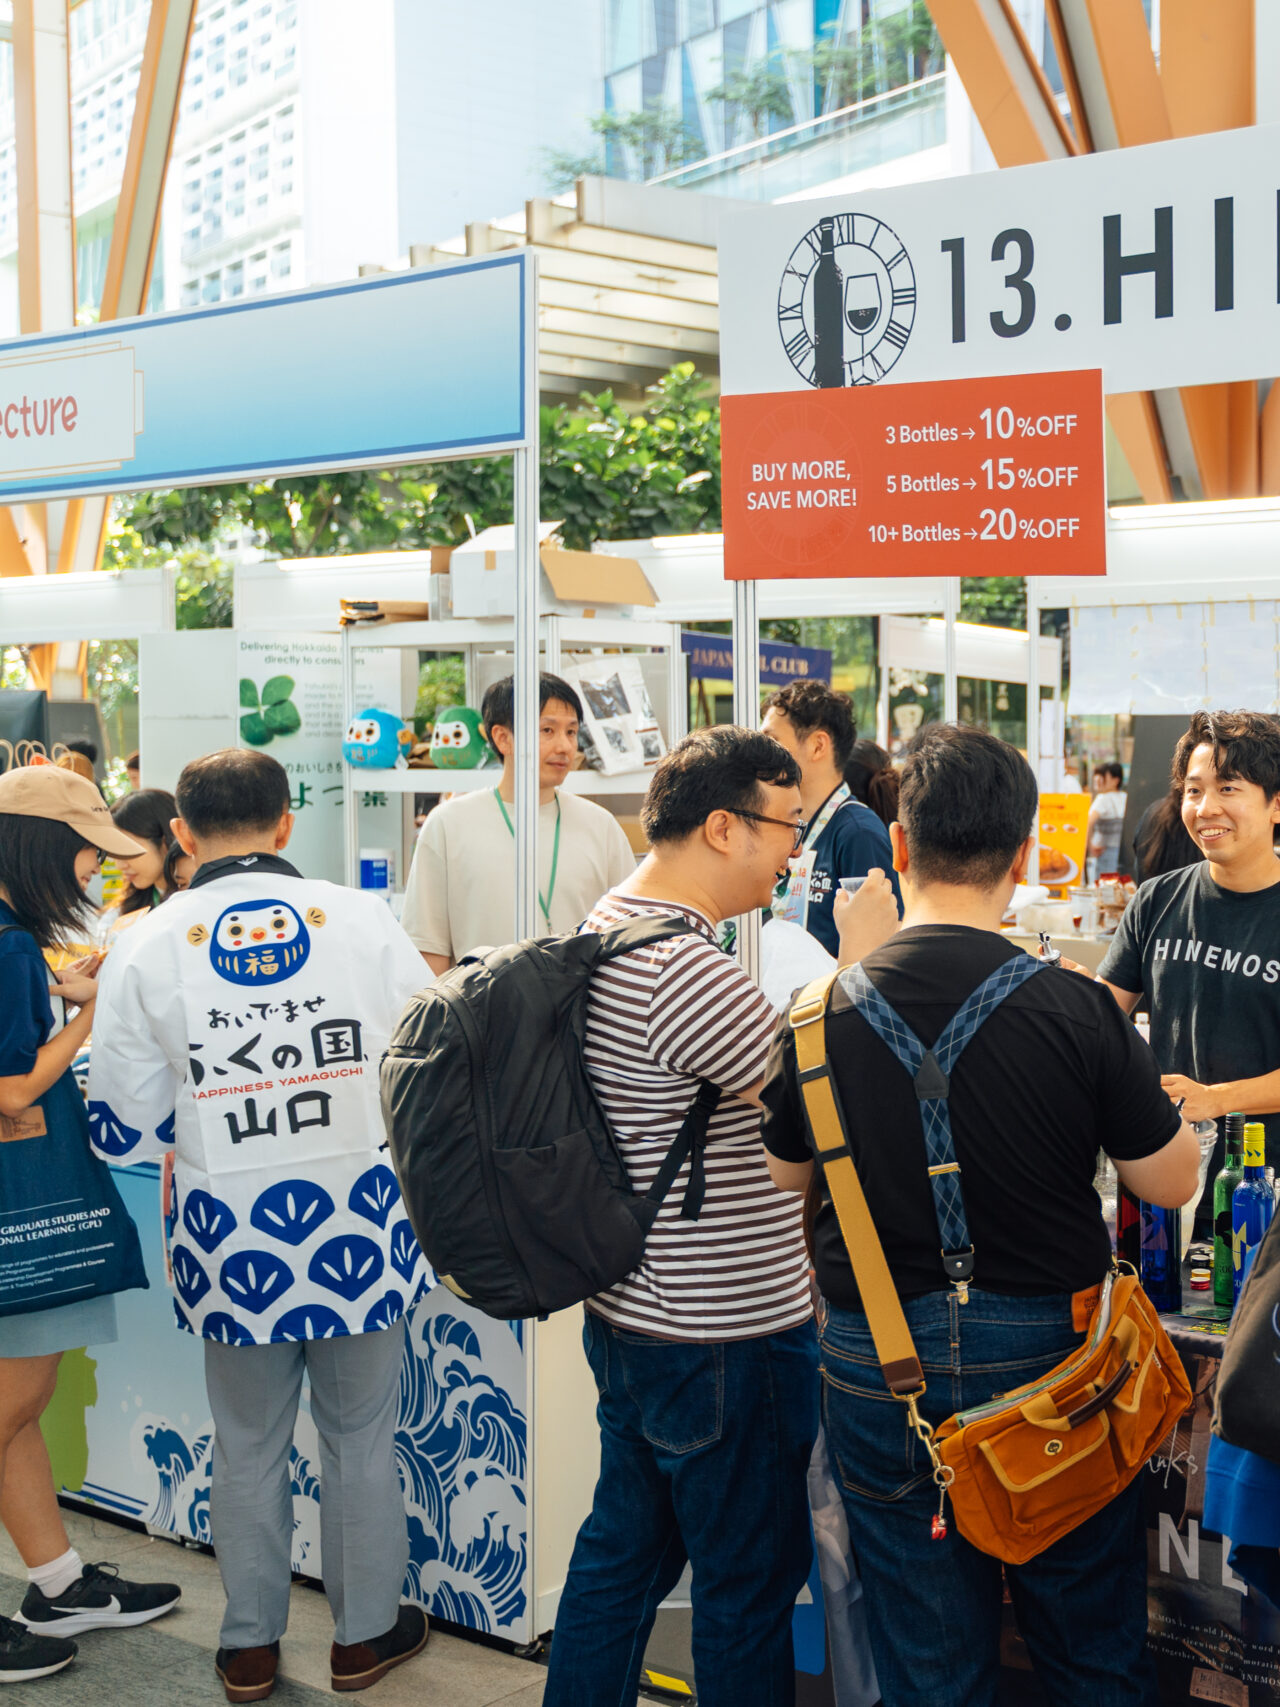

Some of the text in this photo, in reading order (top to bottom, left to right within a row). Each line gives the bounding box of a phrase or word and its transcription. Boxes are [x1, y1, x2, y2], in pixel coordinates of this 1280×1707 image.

[0, 395, 78, 439] cture
[885, 425, 897, 444] 3
[899, 421, 959, 443] Bottles
[752, 460, 851, 482] BUY MORE,
[886, 474, 897, 493] 5
[901, 470, 960, 492] Bottles
[747, 488, 857, 510] SAVE MORE!
[868, 524, 900, 544] 10+
[902, 523, 961, 542] Bottles
[240, 641, 289, 653] Delivering
[264, 655, 300, 665] directly
[303, 655, 313, 664] to
[771, 655, 809, 676] CLUB
[245, 949, 280, 977] 福
[207, 996, 326, 1030] おいでませ
[279, 1067, 363, 1087] YAMAGUCHI
[224, 1090, 332, 1144] 山口
[1, 1207, 110, 1235] GRADUATE STUDIES AND
[27, 1224, 75, 1241] LEARNING
[79, 1218, 103, 1232] (GPL)
